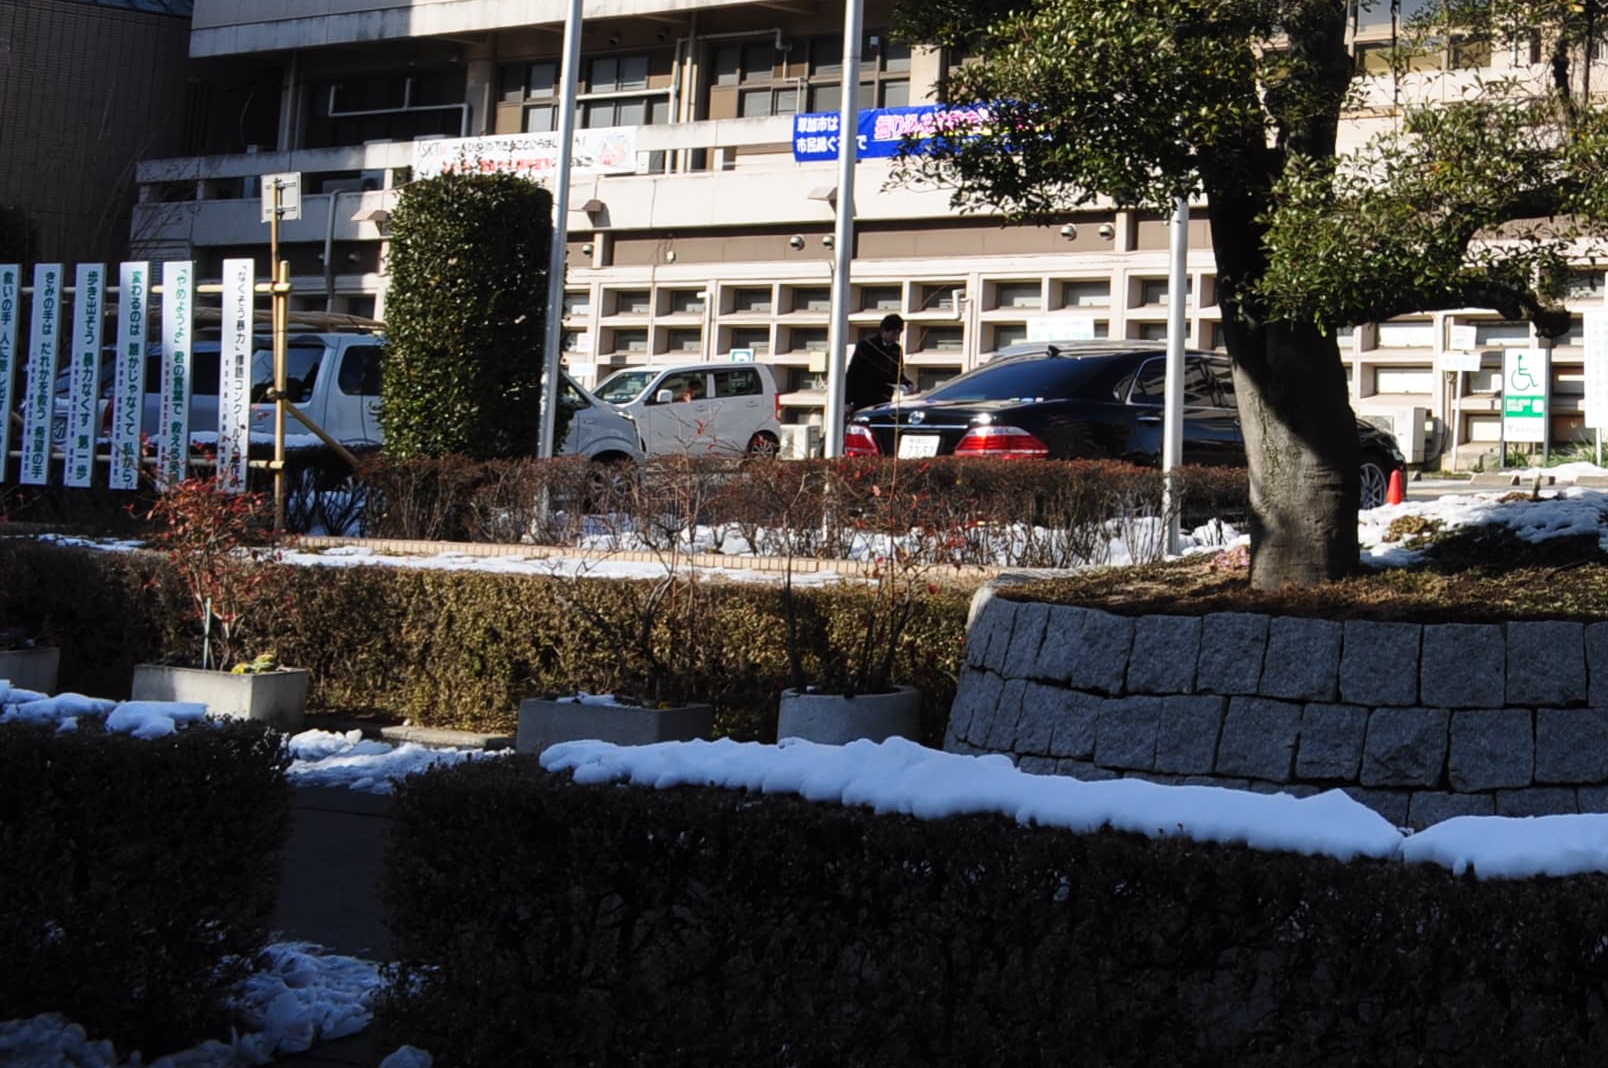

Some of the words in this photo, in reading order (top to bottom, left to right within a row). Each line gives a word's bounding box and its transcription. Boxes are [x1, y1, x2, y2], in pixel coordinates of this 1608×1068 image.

[796, 116, 838, 133] 草加市は
[796, 135, 867, 154] 市民総ぐで
[42, 271, 56, 336] きみの手は
